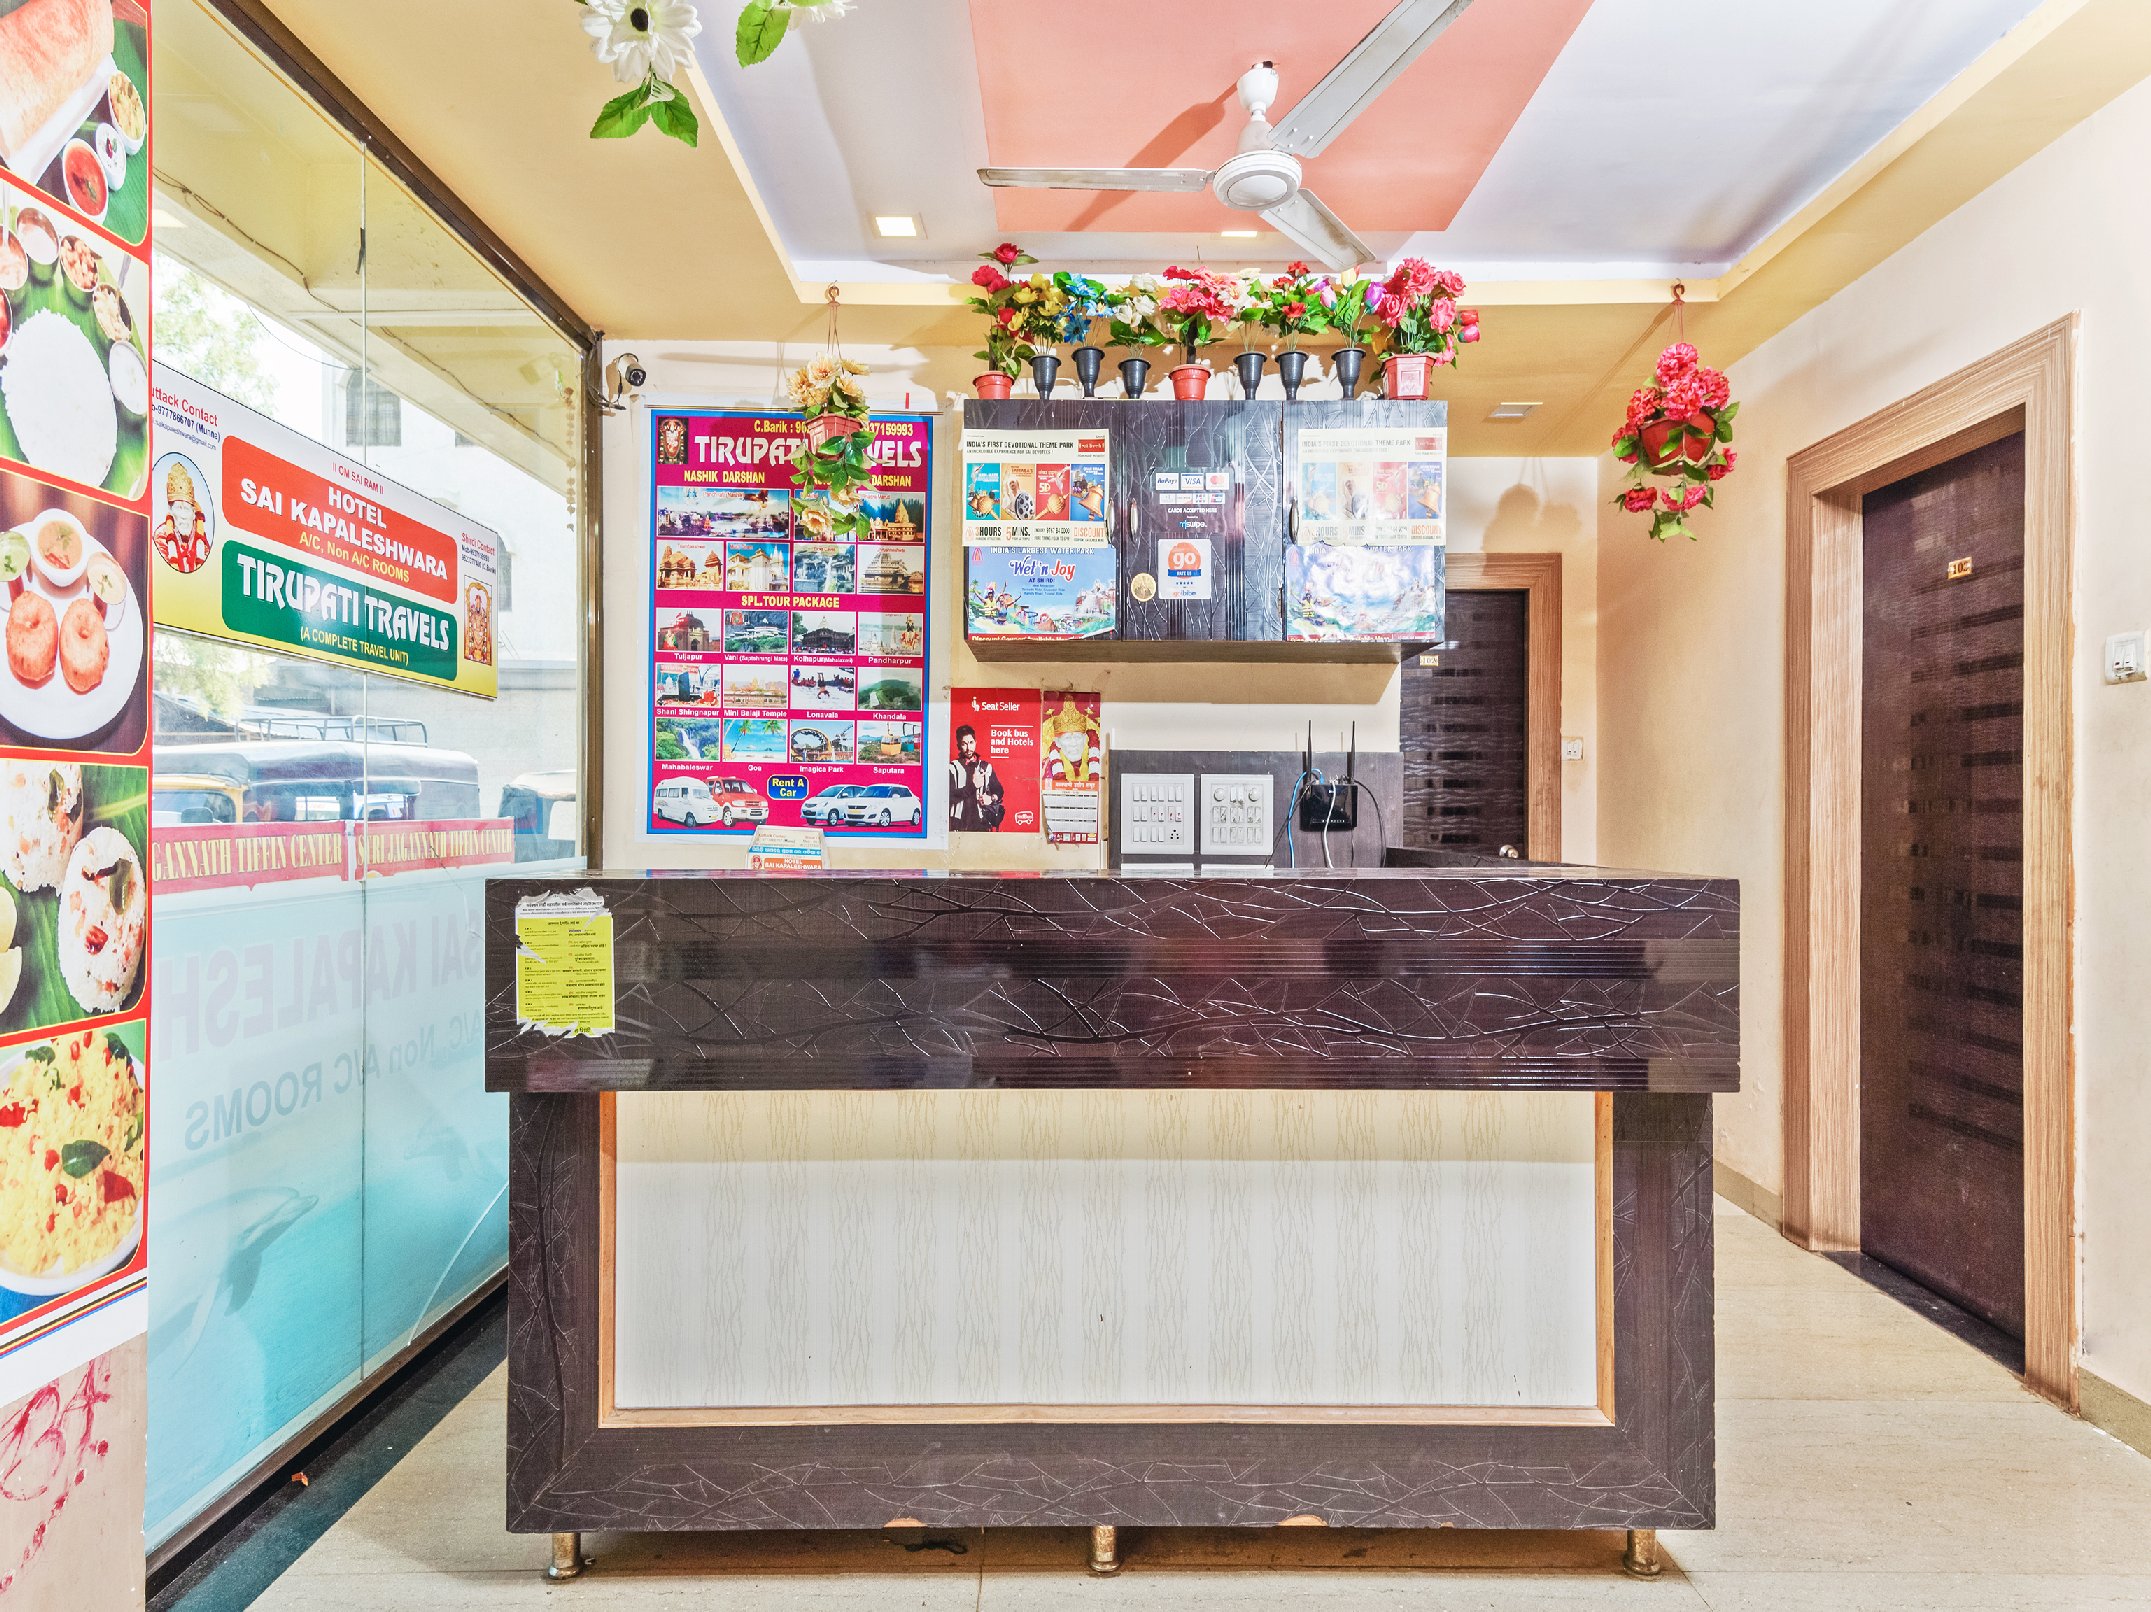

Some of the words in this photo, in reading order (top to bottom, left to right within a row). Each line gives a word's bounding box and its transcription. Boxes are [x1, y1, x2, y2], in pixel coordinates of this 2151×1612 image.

[181, 399, 218, 427] Contact
[754, 420, 788, 434] C.Barik
[684, 470, 718, 482] NASHIK
[723, 471, 765, 483] DARSHAN
[871, 474, 912, 487] DARSHAN
[1185, 477, 1201, 485] VISA
[364, 476, 379, 493] RAM
[328, 487, 387, 529] HOTEL
[240, 478, 283, 517] SAI
[291, 499, 448, 580] KAPALESHWARA
[327, 541, 349, 561] Non
[351, 549, 371, 570] A/C
[372, 560, 410, 583] ROOMS
[1173, 552, 1197, 570] go
[1009, 555, 1036, 576] Wet
[1051, 559, 1076, 581] Joy
[237, 553, 360, 628] TIRUPATI
[364, 595, 449, 651] TRAVELS
[792, 597, 839, 608] PACKAGE
[311, 630, 358, 653] COMPLETE
[360, 640, 389, 660] TRAVEL
[389, 648, 409, 666] UNIT)
[674, 653, 703, 661] Tuljapur
[723, 709, 739, 717] Mini
[806, 711, 839, 719] Lonavala
[991, 738, 1006, 746] and
[1007, 738, 1034, 747] Hotels
[991, 746, 1010, 754] here
[800, 765, 827, 774] Imagica
[772, 778, 795, 788] Rent
[797, 778, 805, 788] A
[779, 787, 797, 798] Car
[235, 836, 287, 873] TIFFIN
[290, 833, 343, 868] CENTER
